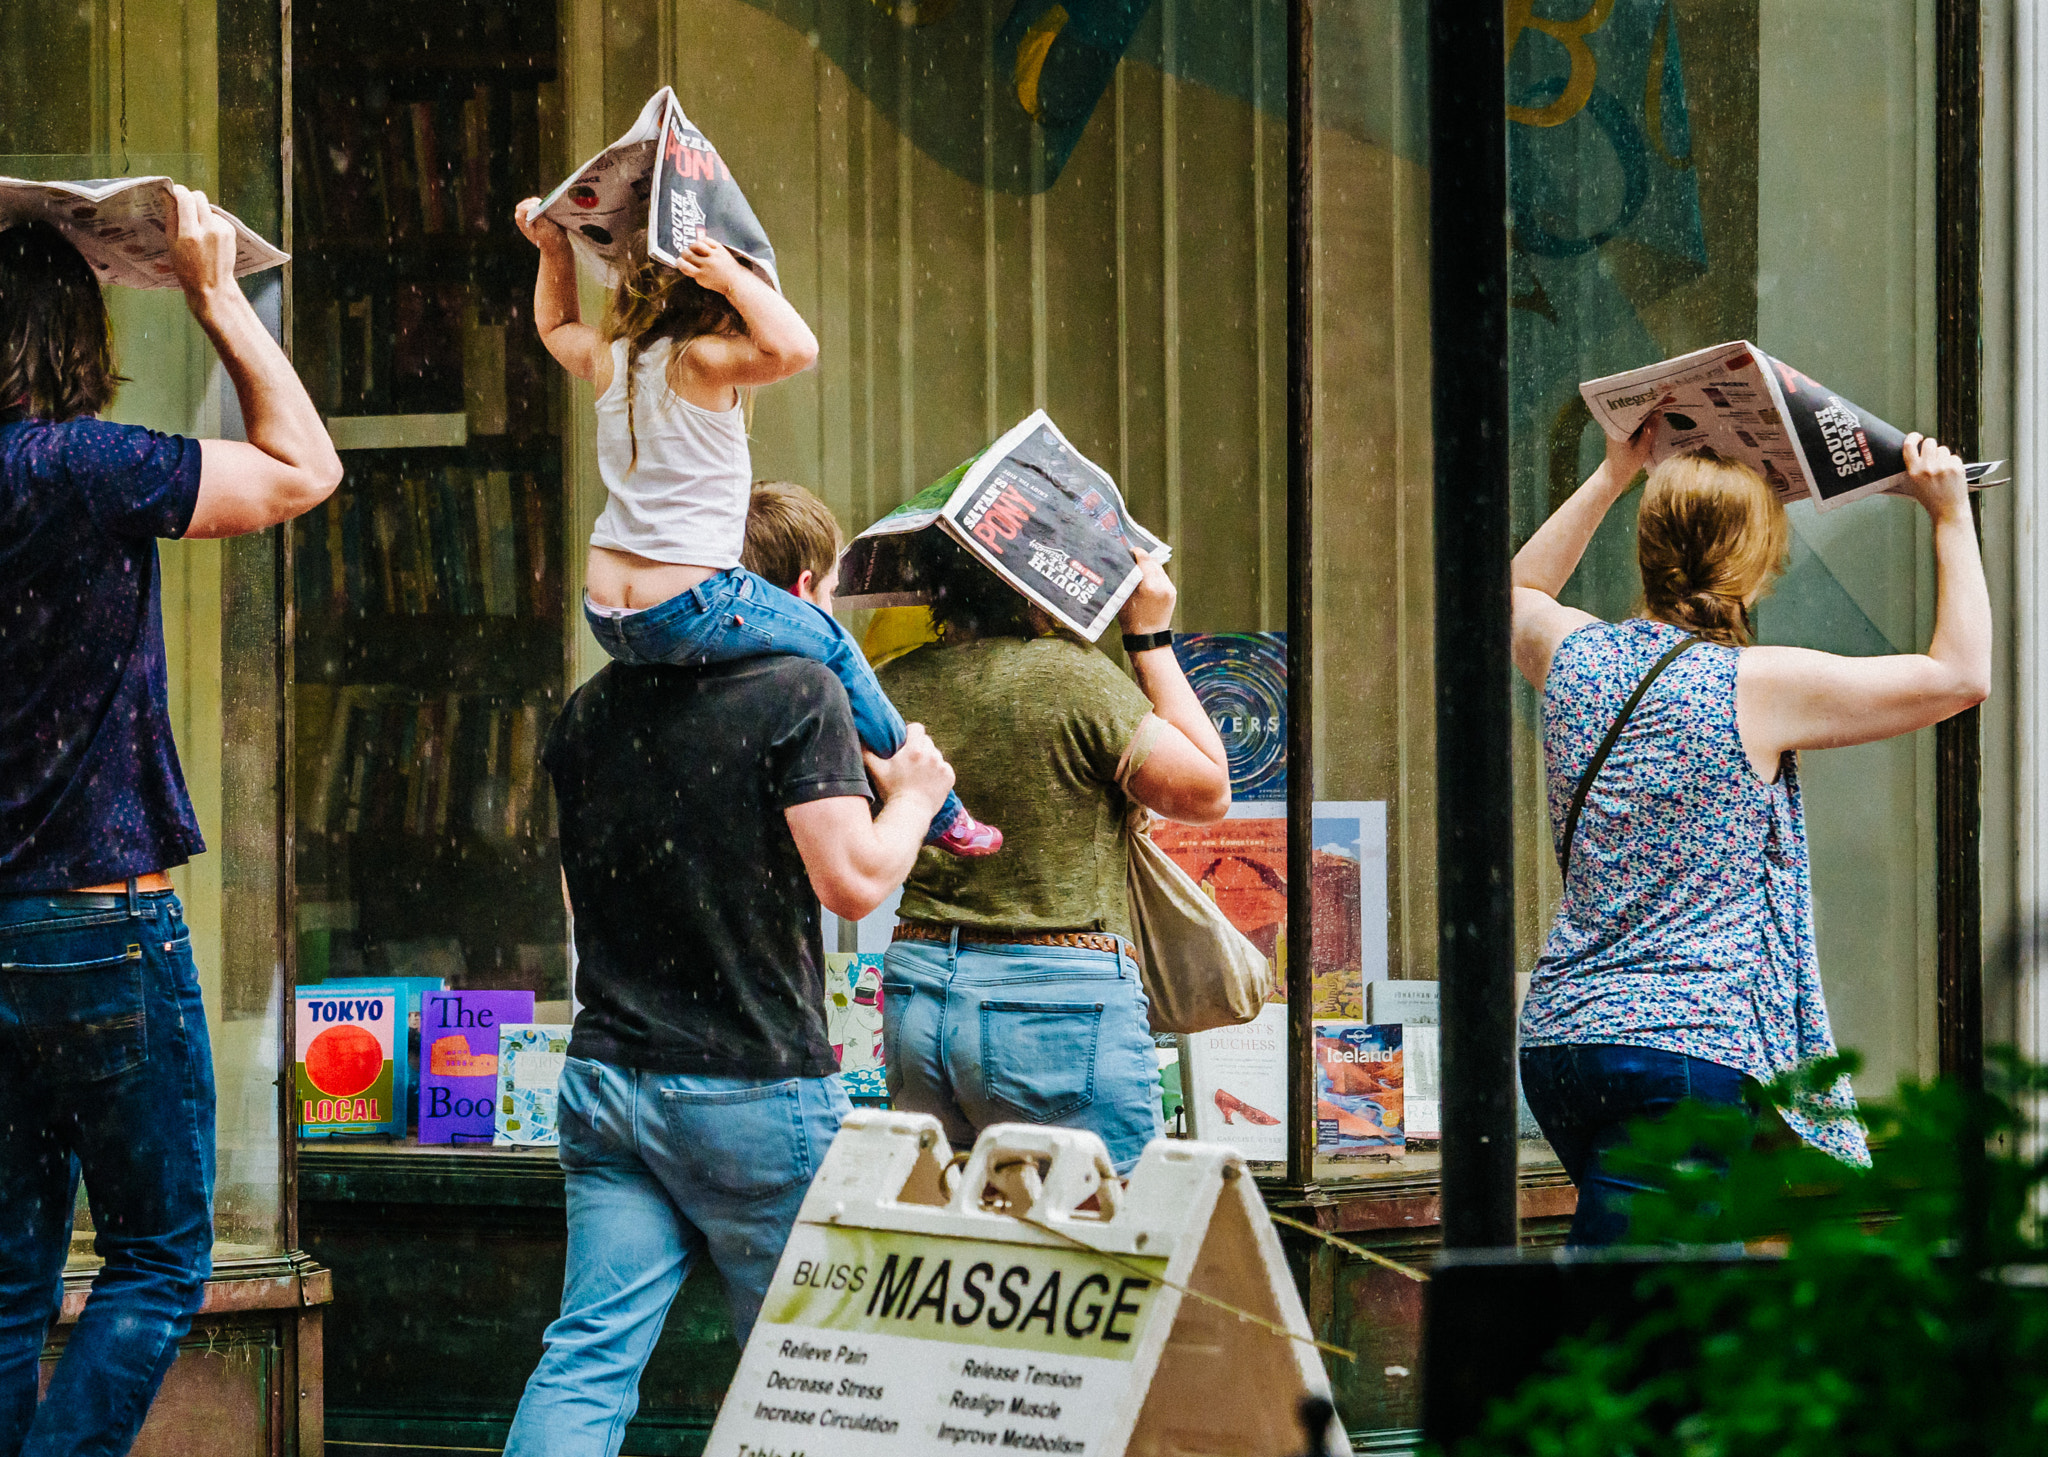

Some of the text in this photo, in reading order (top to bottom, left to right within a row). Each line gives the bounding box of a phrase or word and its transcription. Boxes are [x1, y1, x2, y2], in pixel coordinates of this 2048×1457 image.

[670, 188, 684, 253] SOUTH
[1814, 407, 1854, 478] SOUTH
[1828, 405, 1866, 473] STREET
[973, 484, 1037, 555] PONY
[1027, 553, 1093, 605] SOUTH
[1035, 551, 1100, 595] STREET
[308, 1000, 383, 1022] TOKYO
[430, 997, 494, 1028] The
[1210, 1038, 1276, 1051] DUCHESS
[1327, 1046, 1393, 1063] Iceland
[304, 1098, 381, 1123] LOCAL
[427, 1087, 495, 1118] Boo
[793, 1253, 1152, 1343] BLISS MASSAGE
[778, 1339, 869, 1366] Relieve Pain
[766, 1370, 885, 1401] Decrease Stress
[961, 1358, 1083, 1389] Release Tension
[754, 1401, 900, 1435] Increase Circulation
[949, 1388, 1062, 1420] Realign Muscle
[937, 1420, 1086, 1455] Improve Metabolism
